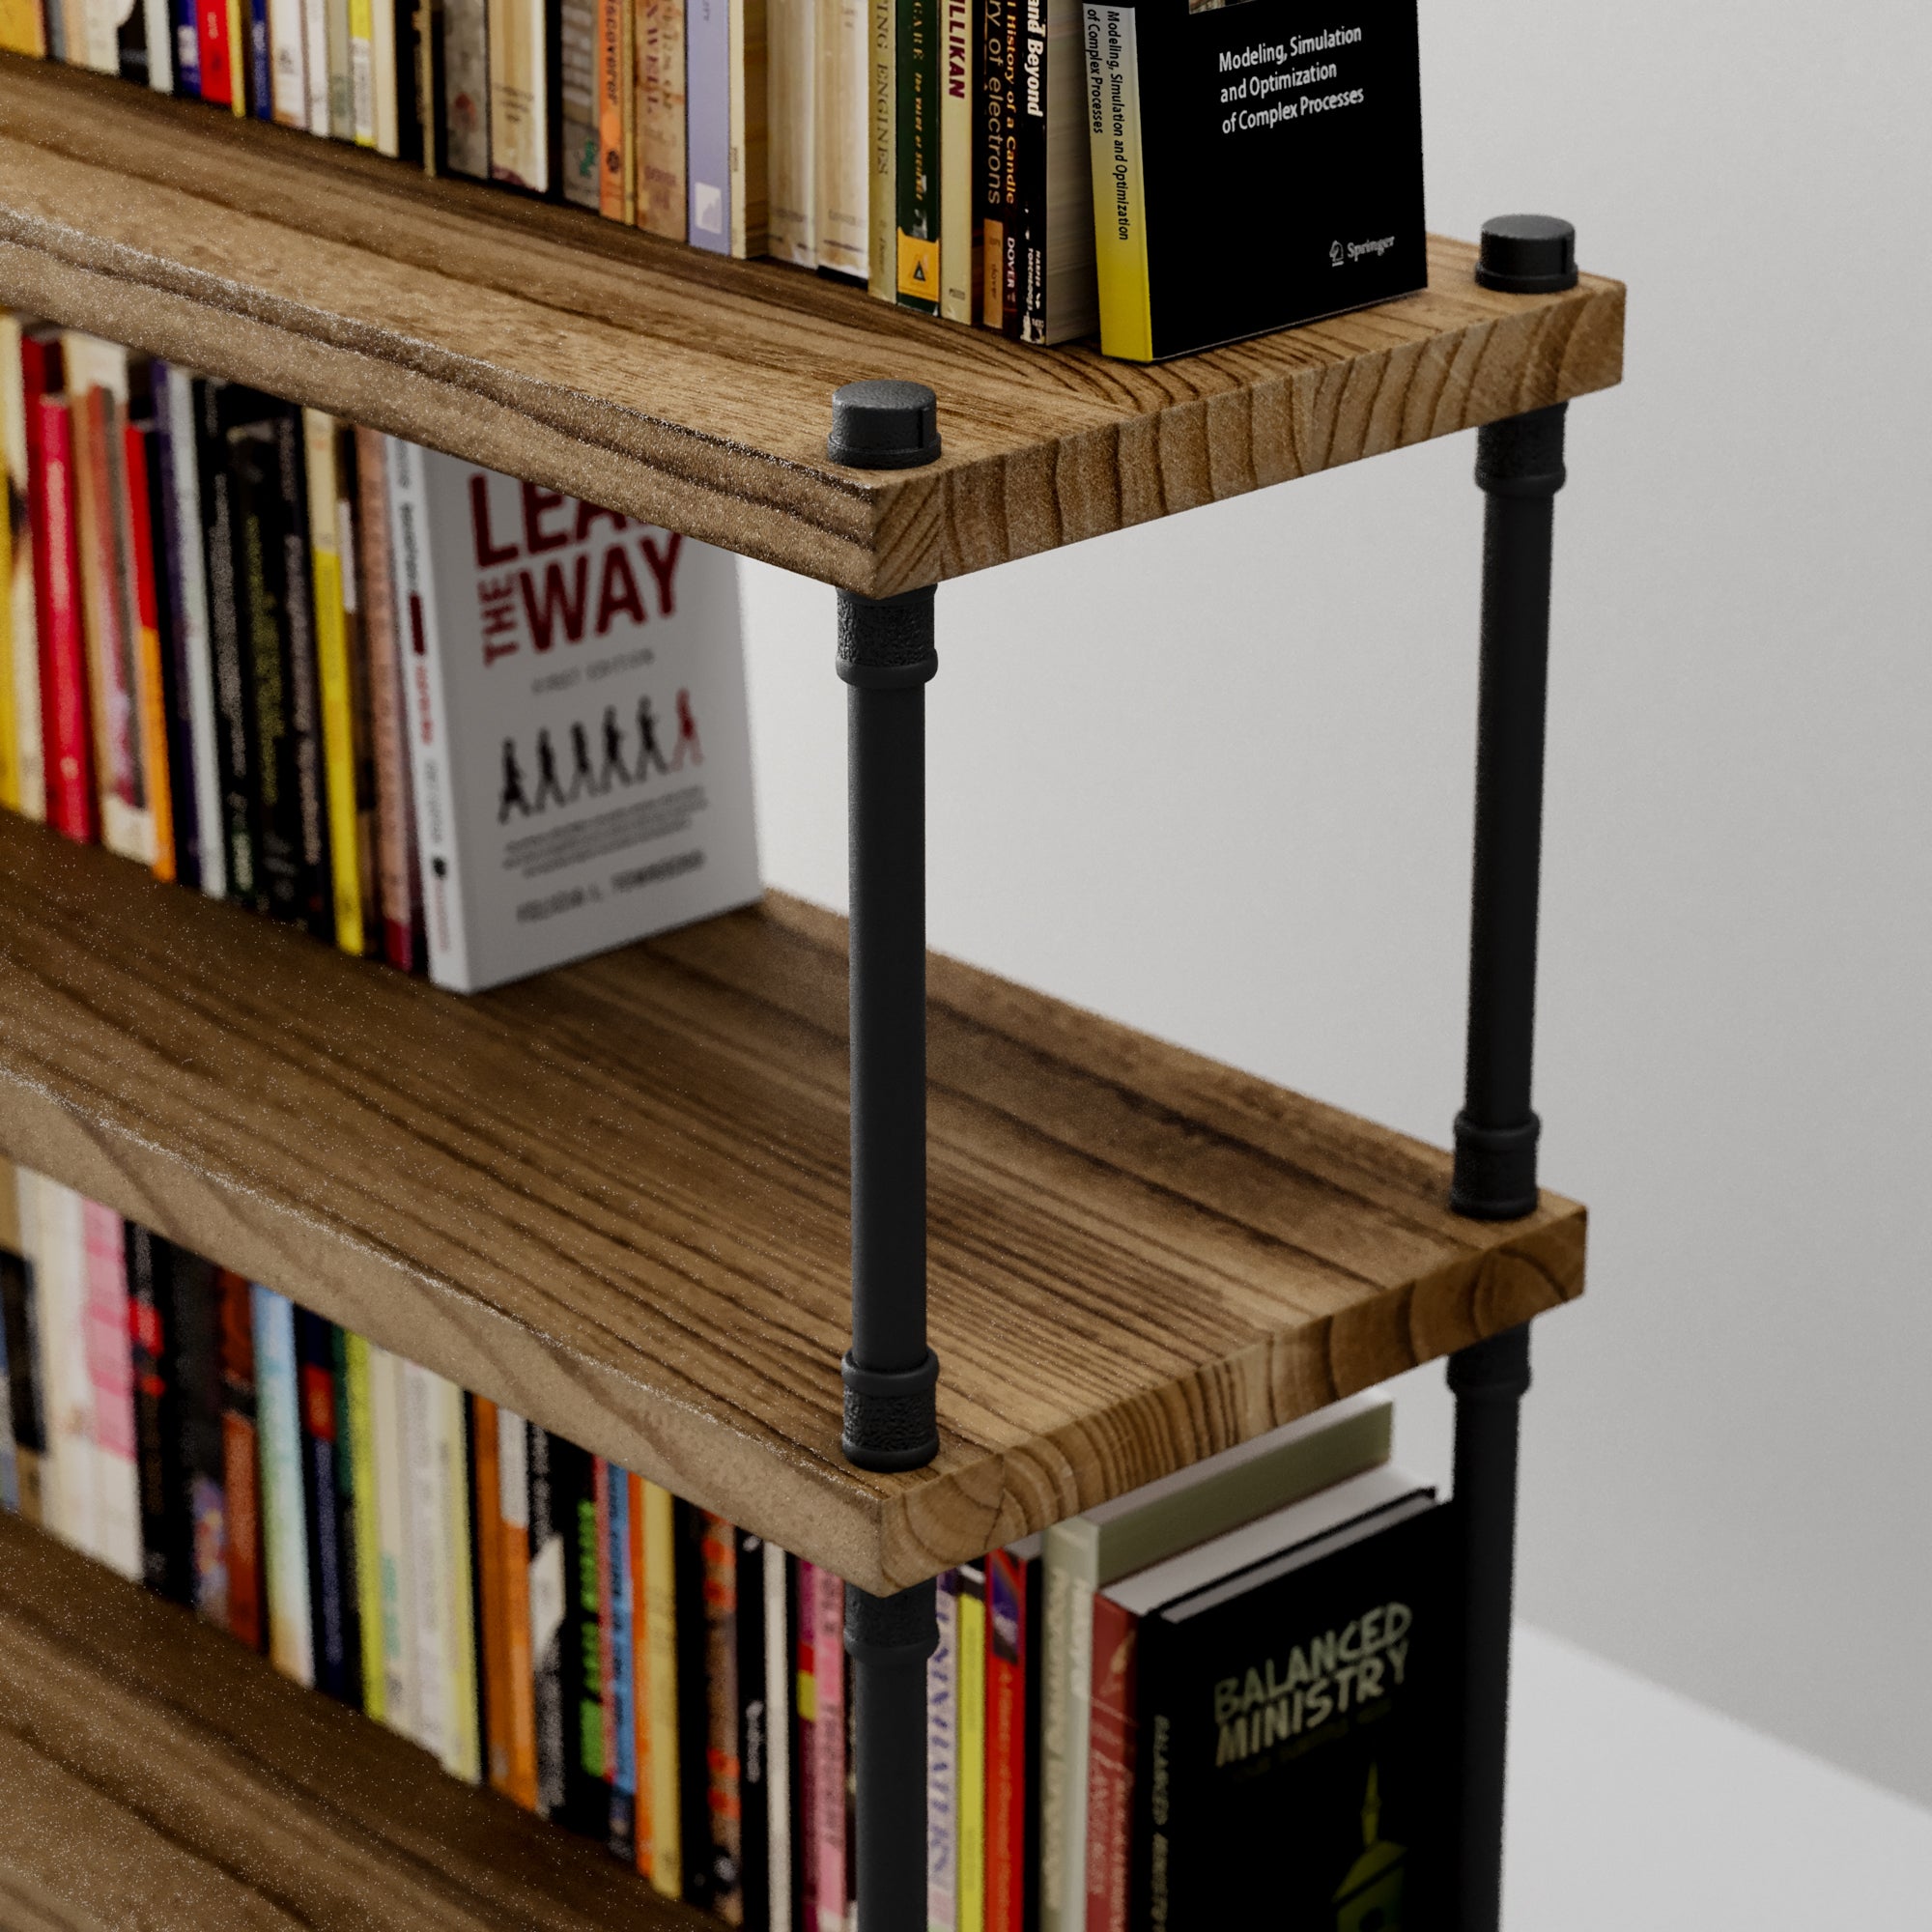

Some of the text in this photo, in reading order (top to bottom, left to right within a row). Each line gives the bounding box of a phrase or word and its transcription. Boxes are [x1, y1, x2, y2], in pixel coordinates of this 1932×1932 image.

[987, 38, 1004, 67] of
[1004, 14, 1016, 85] History
[1024, 39, 1044, 118] Beyond
[1086, 9, 1103, 134] of Complex Processes
[1217, 25, 1363, 73] Modeling, Simulation
[1219, 61, 1338, 103] and Optimization
[876, 63, 889, 176] ENGINES
[1007, 91, 1016, 114] of
[1007, 117, 1015, 129] a
[1106, 11, 1129, 242] Modeling, Simulation and Optimization
[1221, 87, 1365, 134] of Complex Processes
[987, 76, 1003, 205] electrons
[1006, 134, 1017, 205] Candle
[1007, 236, 1016, 289] DOVER
[1347, 236, 1396, 263] Springer
[469, 471, 660, 571] LEA
[476, 572, 521, 669] THE
[520, 531, 684, 655] WAY
[1213, 1601, 1413, 1725] BALANCED
[1215, 1639, 1410, 1769] MINISTRY
